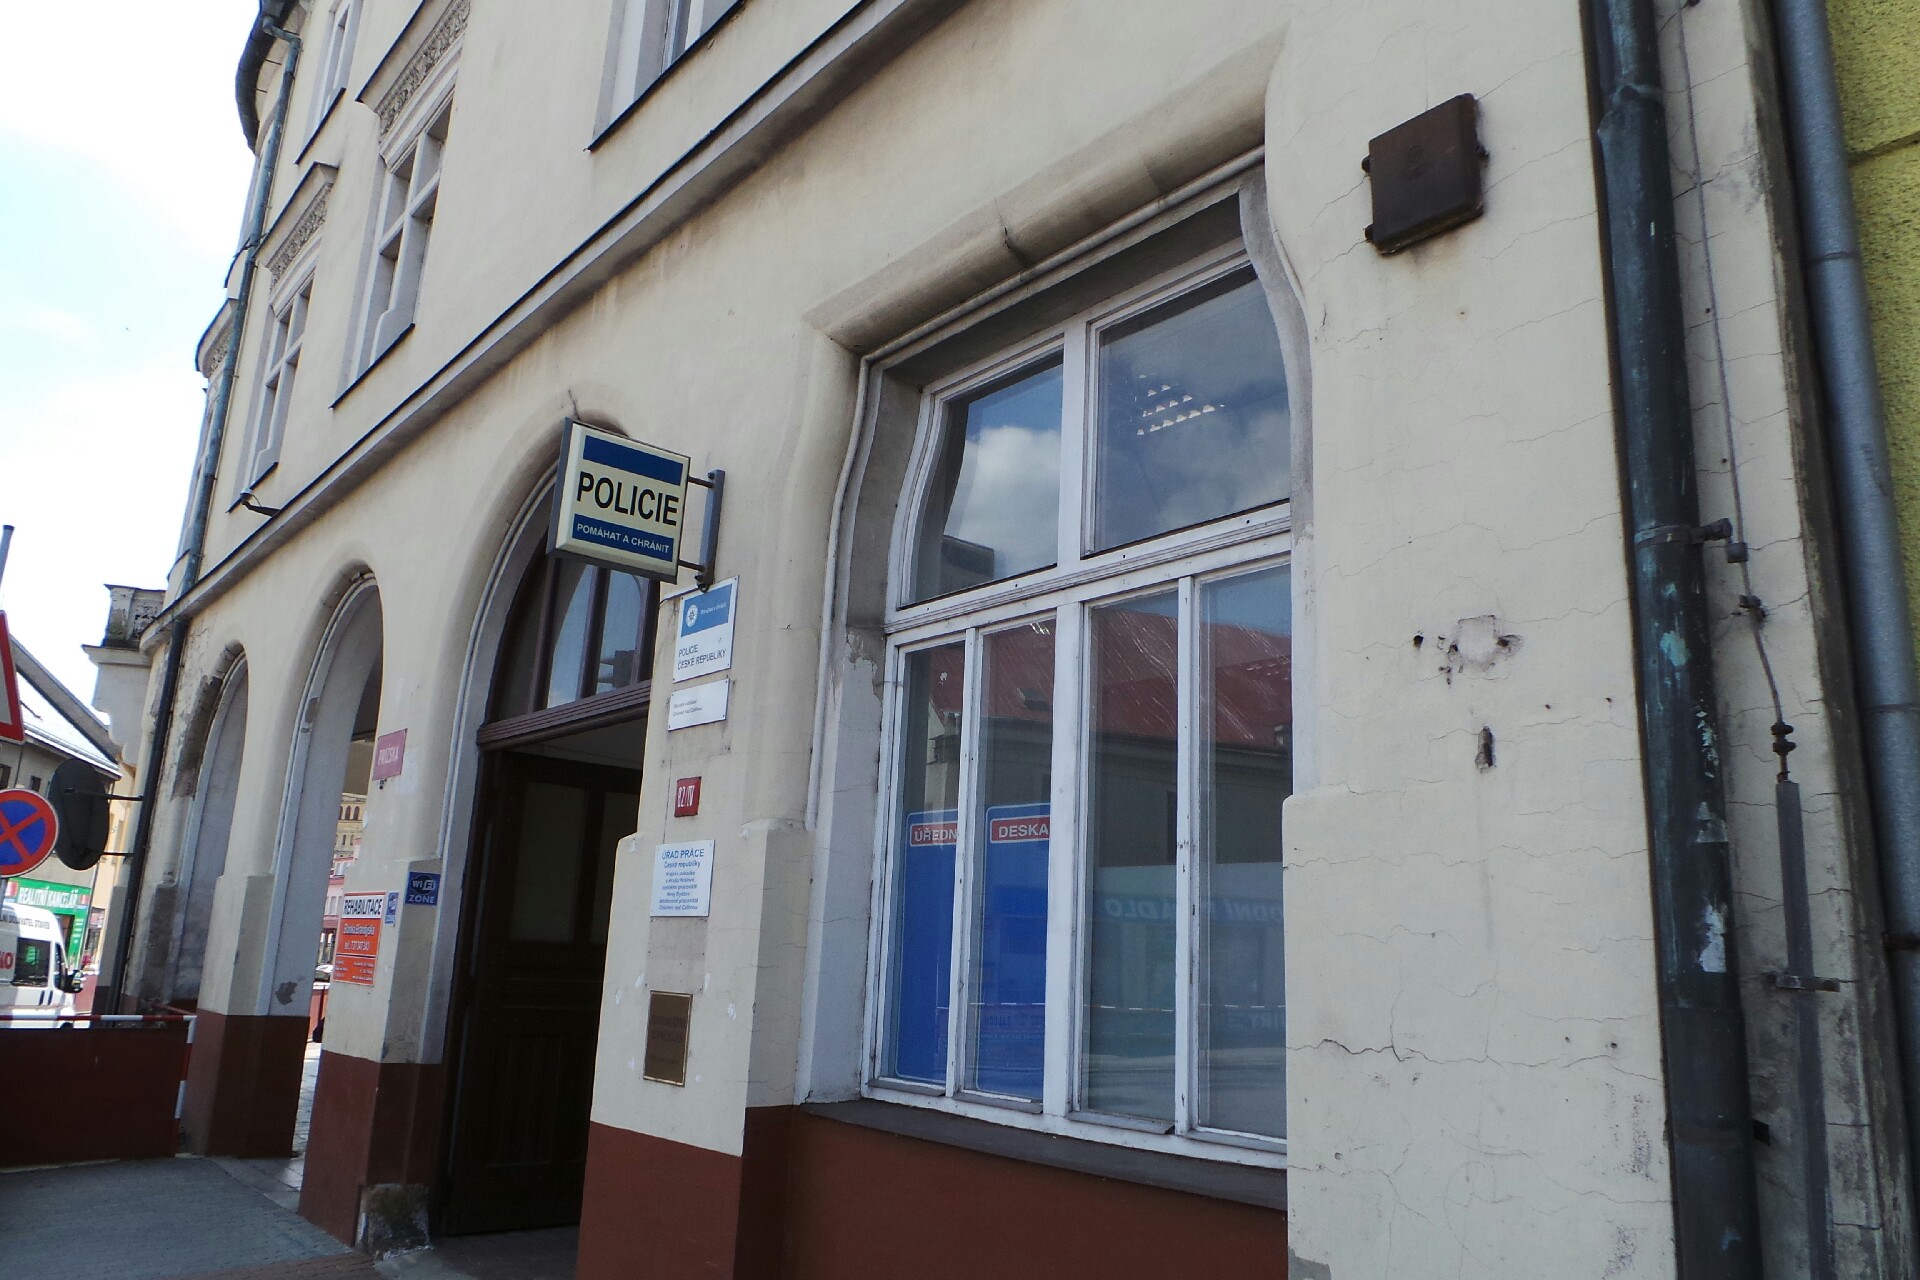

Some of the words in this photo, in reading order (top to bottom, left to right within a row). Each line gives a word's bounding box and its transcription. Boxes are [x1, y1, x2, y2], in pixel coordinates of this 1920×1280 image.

[576, 470, 680, 527] POLICIE
[577, 523, 622, 541] POMÁHAT
[622, 535, 630, 544] A
[631, 536, 670, 554] CHRÁNIT
[678, 644, 699, 658] POLICIE
[695, 648, 727, 665] REPUBLIKY
[914, 827, 958, 842] ÚŘEDN
[998, 823, 1049, 838] DESKA
[680, 848, 705, 858] PRÁCE
[17, 886, 49, 906] REALITNÍ
[46, 889, 79, 909] KANCELÁŘ
[408, 895, 436, 904] ZONE
[343, 899, 383, 915] REHABILITACE
